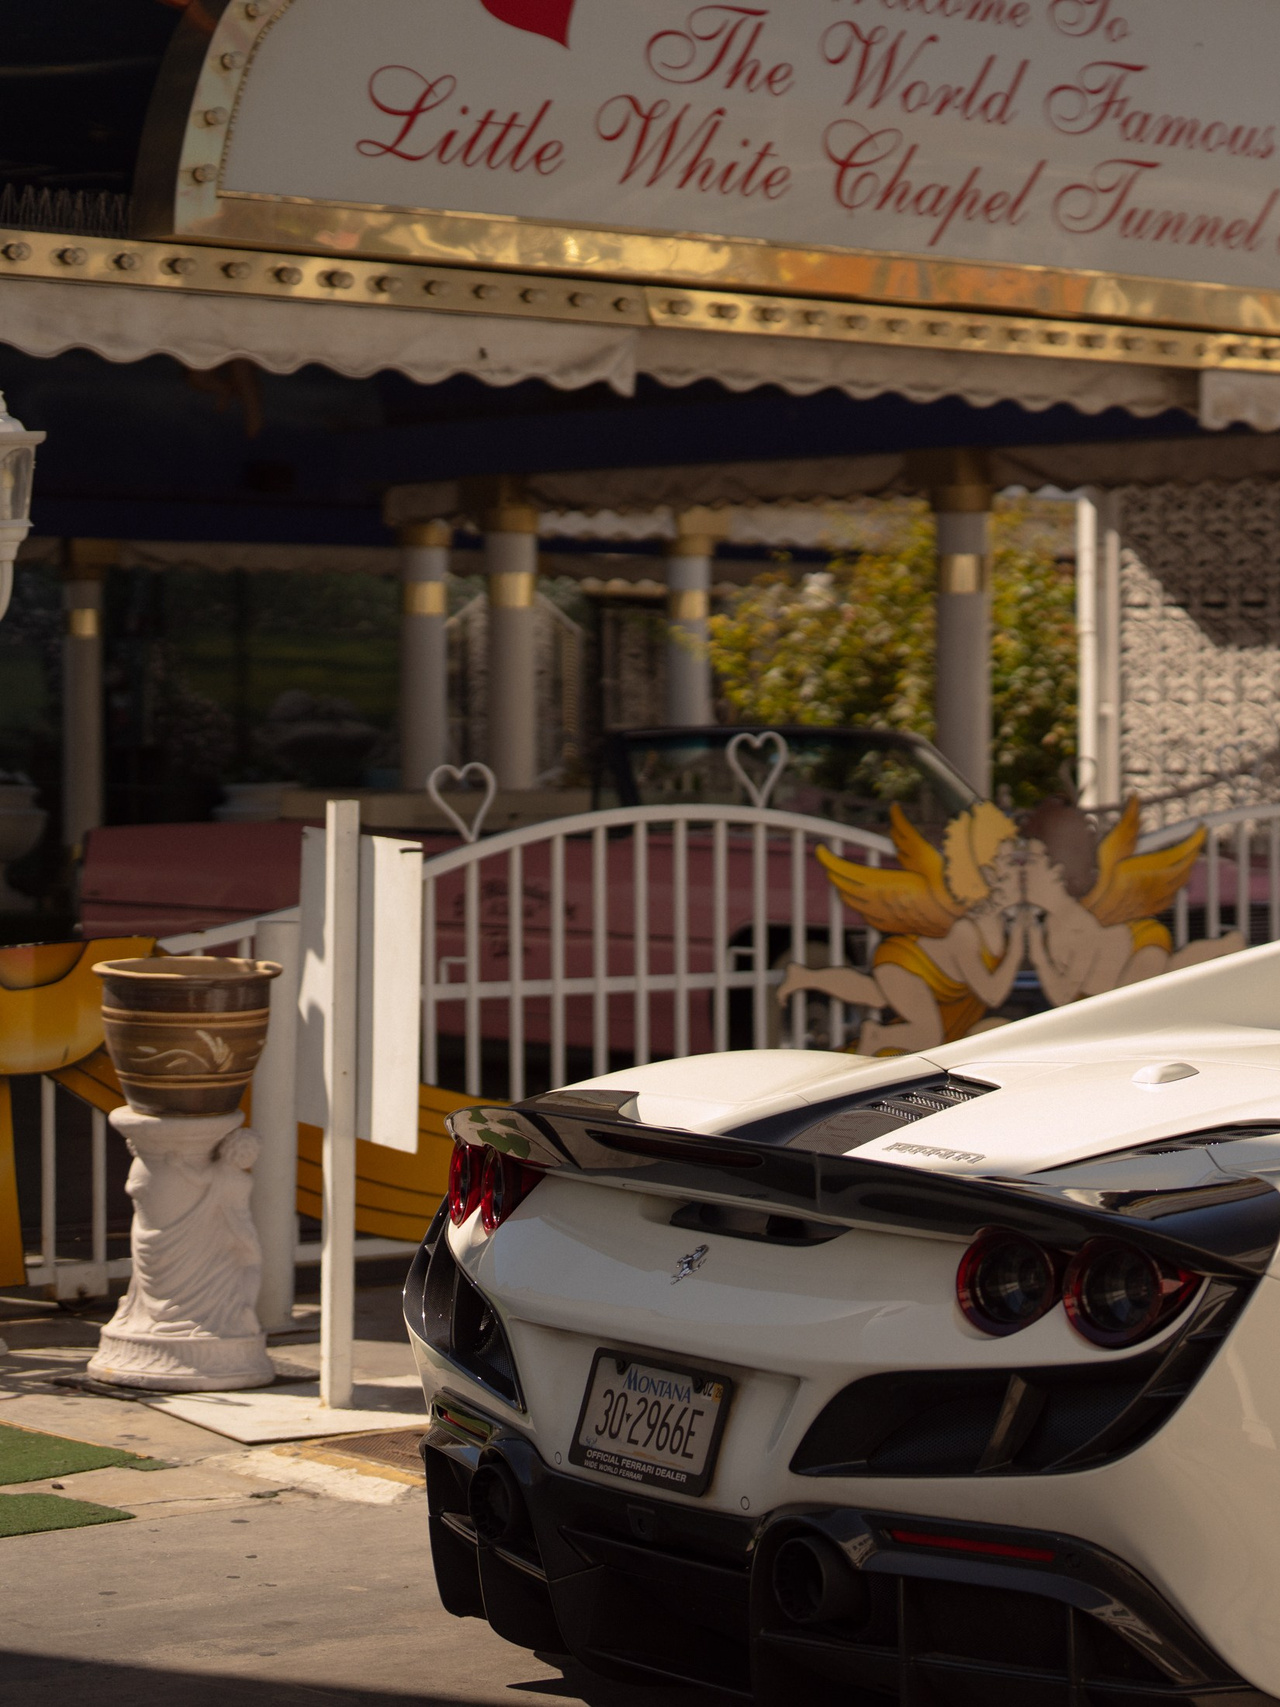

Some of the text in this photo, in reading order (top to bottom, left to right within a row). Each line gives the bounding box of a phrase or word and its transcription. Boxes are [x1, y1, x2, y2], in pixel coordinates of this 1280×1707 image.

[646, 5, 1277, 161] The World Famous
[356, 65, 565, 176] Little
[596, 94, 792, 199] White
[822, 119, 1048, 246] Chapel
[583, 1459, 644, 1481] WIDE WORLD FERRARI
[586, 1450, 687, 1483] OFFICIAL FERRARI DEALER
